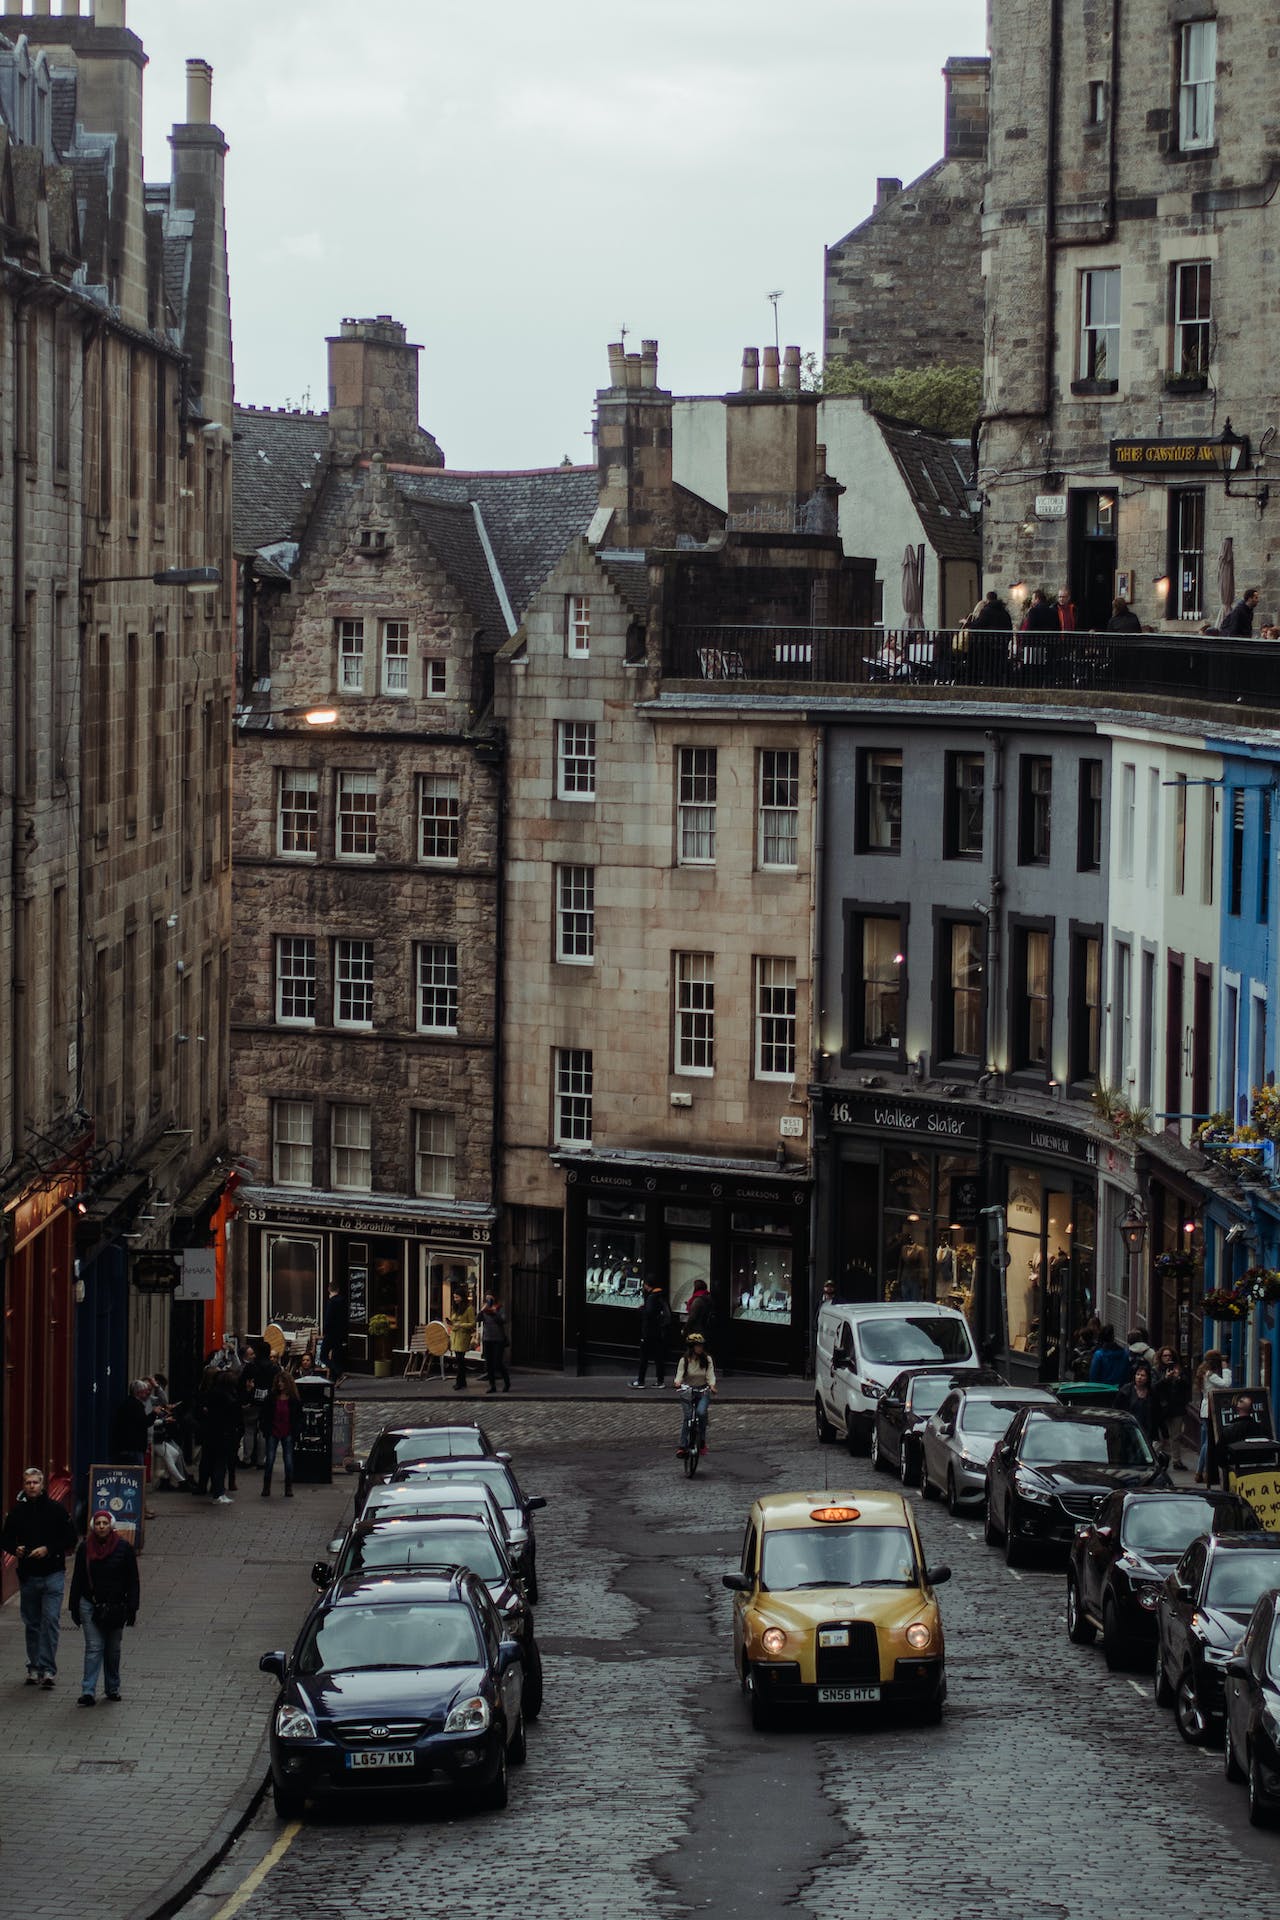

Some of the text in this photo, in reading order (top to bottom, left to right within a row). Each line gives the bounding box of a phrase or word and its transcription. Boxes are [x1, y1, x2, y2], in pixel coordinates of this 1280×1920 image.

[1115, 446, 1142, 462] THE
[1145, 445, 1195, 461] CASTLE
[1037, 497, 1064, 505] VICTORIA
[830, 1102, 966, 1134] 46. Walker Slater
[1030, 1131, 1070, 1153] LADIESWEAR
[590, 1175, 632, 1187] CLARKSONS
[736, 1189, 780, 1201] CLARKSONS
[249, 1208, 266, 1221] 89
[340, 1217, 352, 1229] La
[472, 1229, 490, 1241] 89
[96, 1476, 138, 1488] BOW BAR
[822, 1510, 849, 1521] TAXI
[822, 1688, 875, 1700] SN56 HTC
[388, 1751, 412, 1764] KWX
